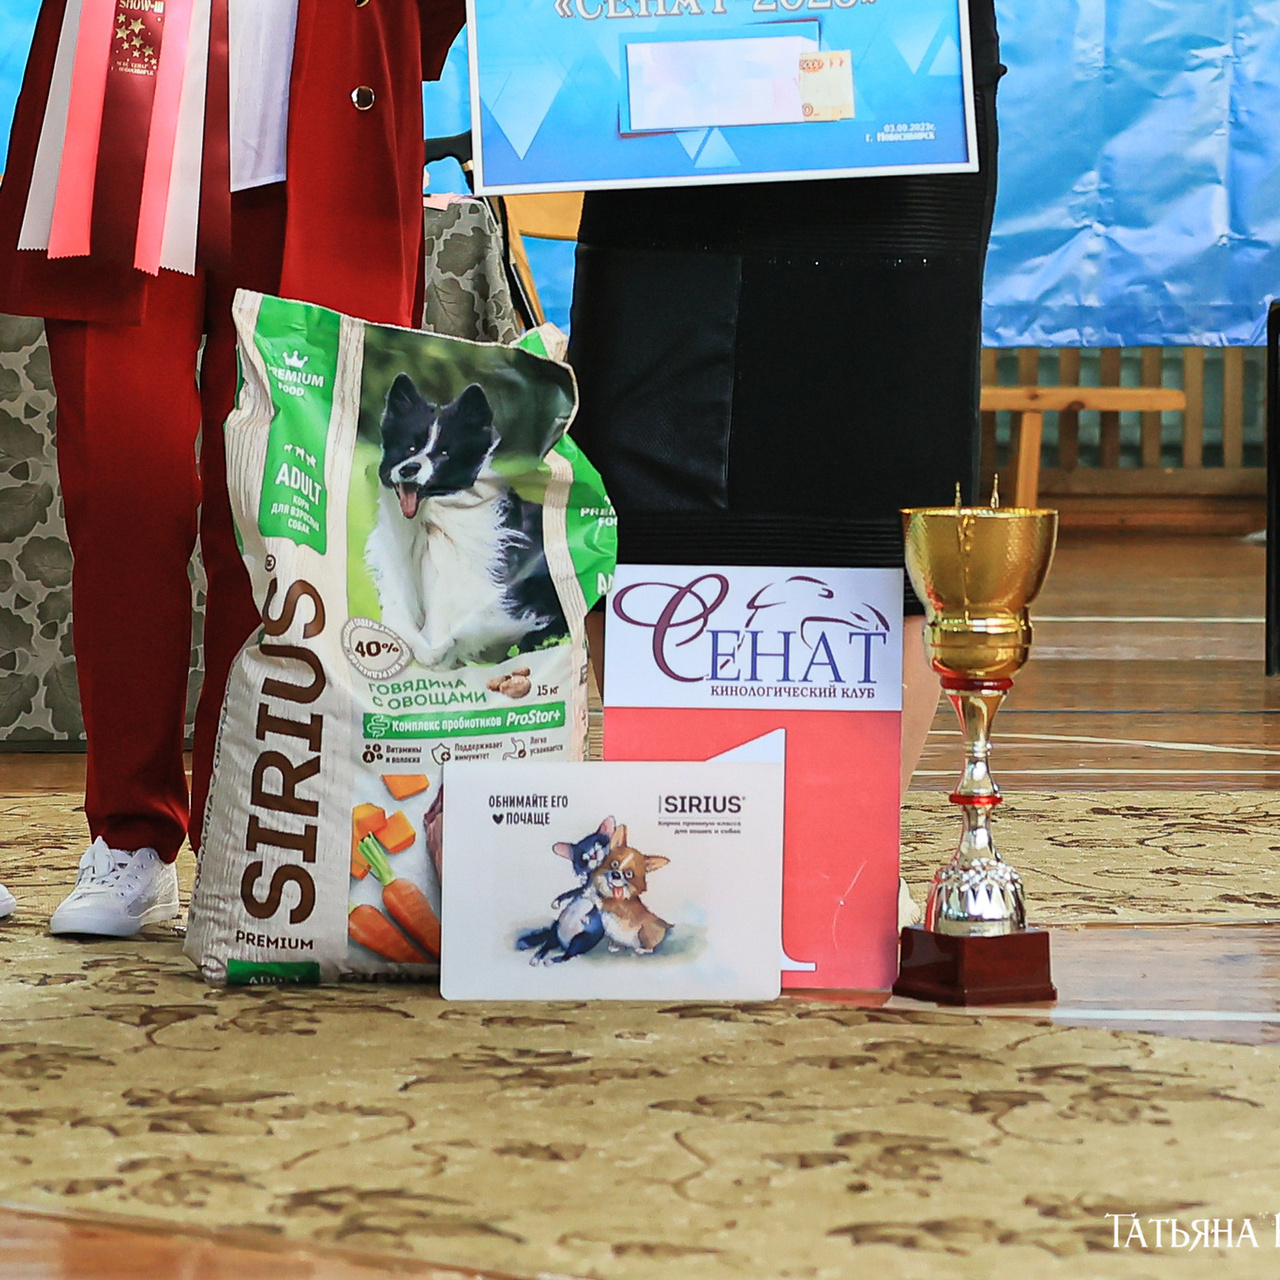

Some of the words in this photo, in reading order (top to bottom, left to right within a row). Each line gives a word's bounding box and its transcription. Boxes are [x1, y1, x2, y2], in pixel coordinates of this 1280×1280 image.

[277, 381, 306, 398] FOOD
[275, 462, 323, 506] ADULT
[354, 640, 400, 658] 40%
[368, 678, 467, 696] ГОВЯДИНА
[537, 684, 548, 697] 15
[711, 684, 837, 699] КИНОЛОГИЧЕСКИЙ
[841, 687, 876, 699] КЛУБ
[372, 696, 384, 708] С
[387, 690, 488, 711] ОВОЩАМИ
[391, 718, 441, 734] Комплекс
[442, 714, 502, 732] пробиотиков
[505, 708, 562, 728] ProStor+
[240, 578, 328, 925] SIRIUS
[488, 792, 548, 809] ОБНИМАЙТЕ
[549, 794, 569, 809] ЕГО
[663, 795, 742, 813] SIRIUS
[505, 811, 551, 826] ПОЧАЩЕ
[235, 929, 314, 951] PREMIUM
